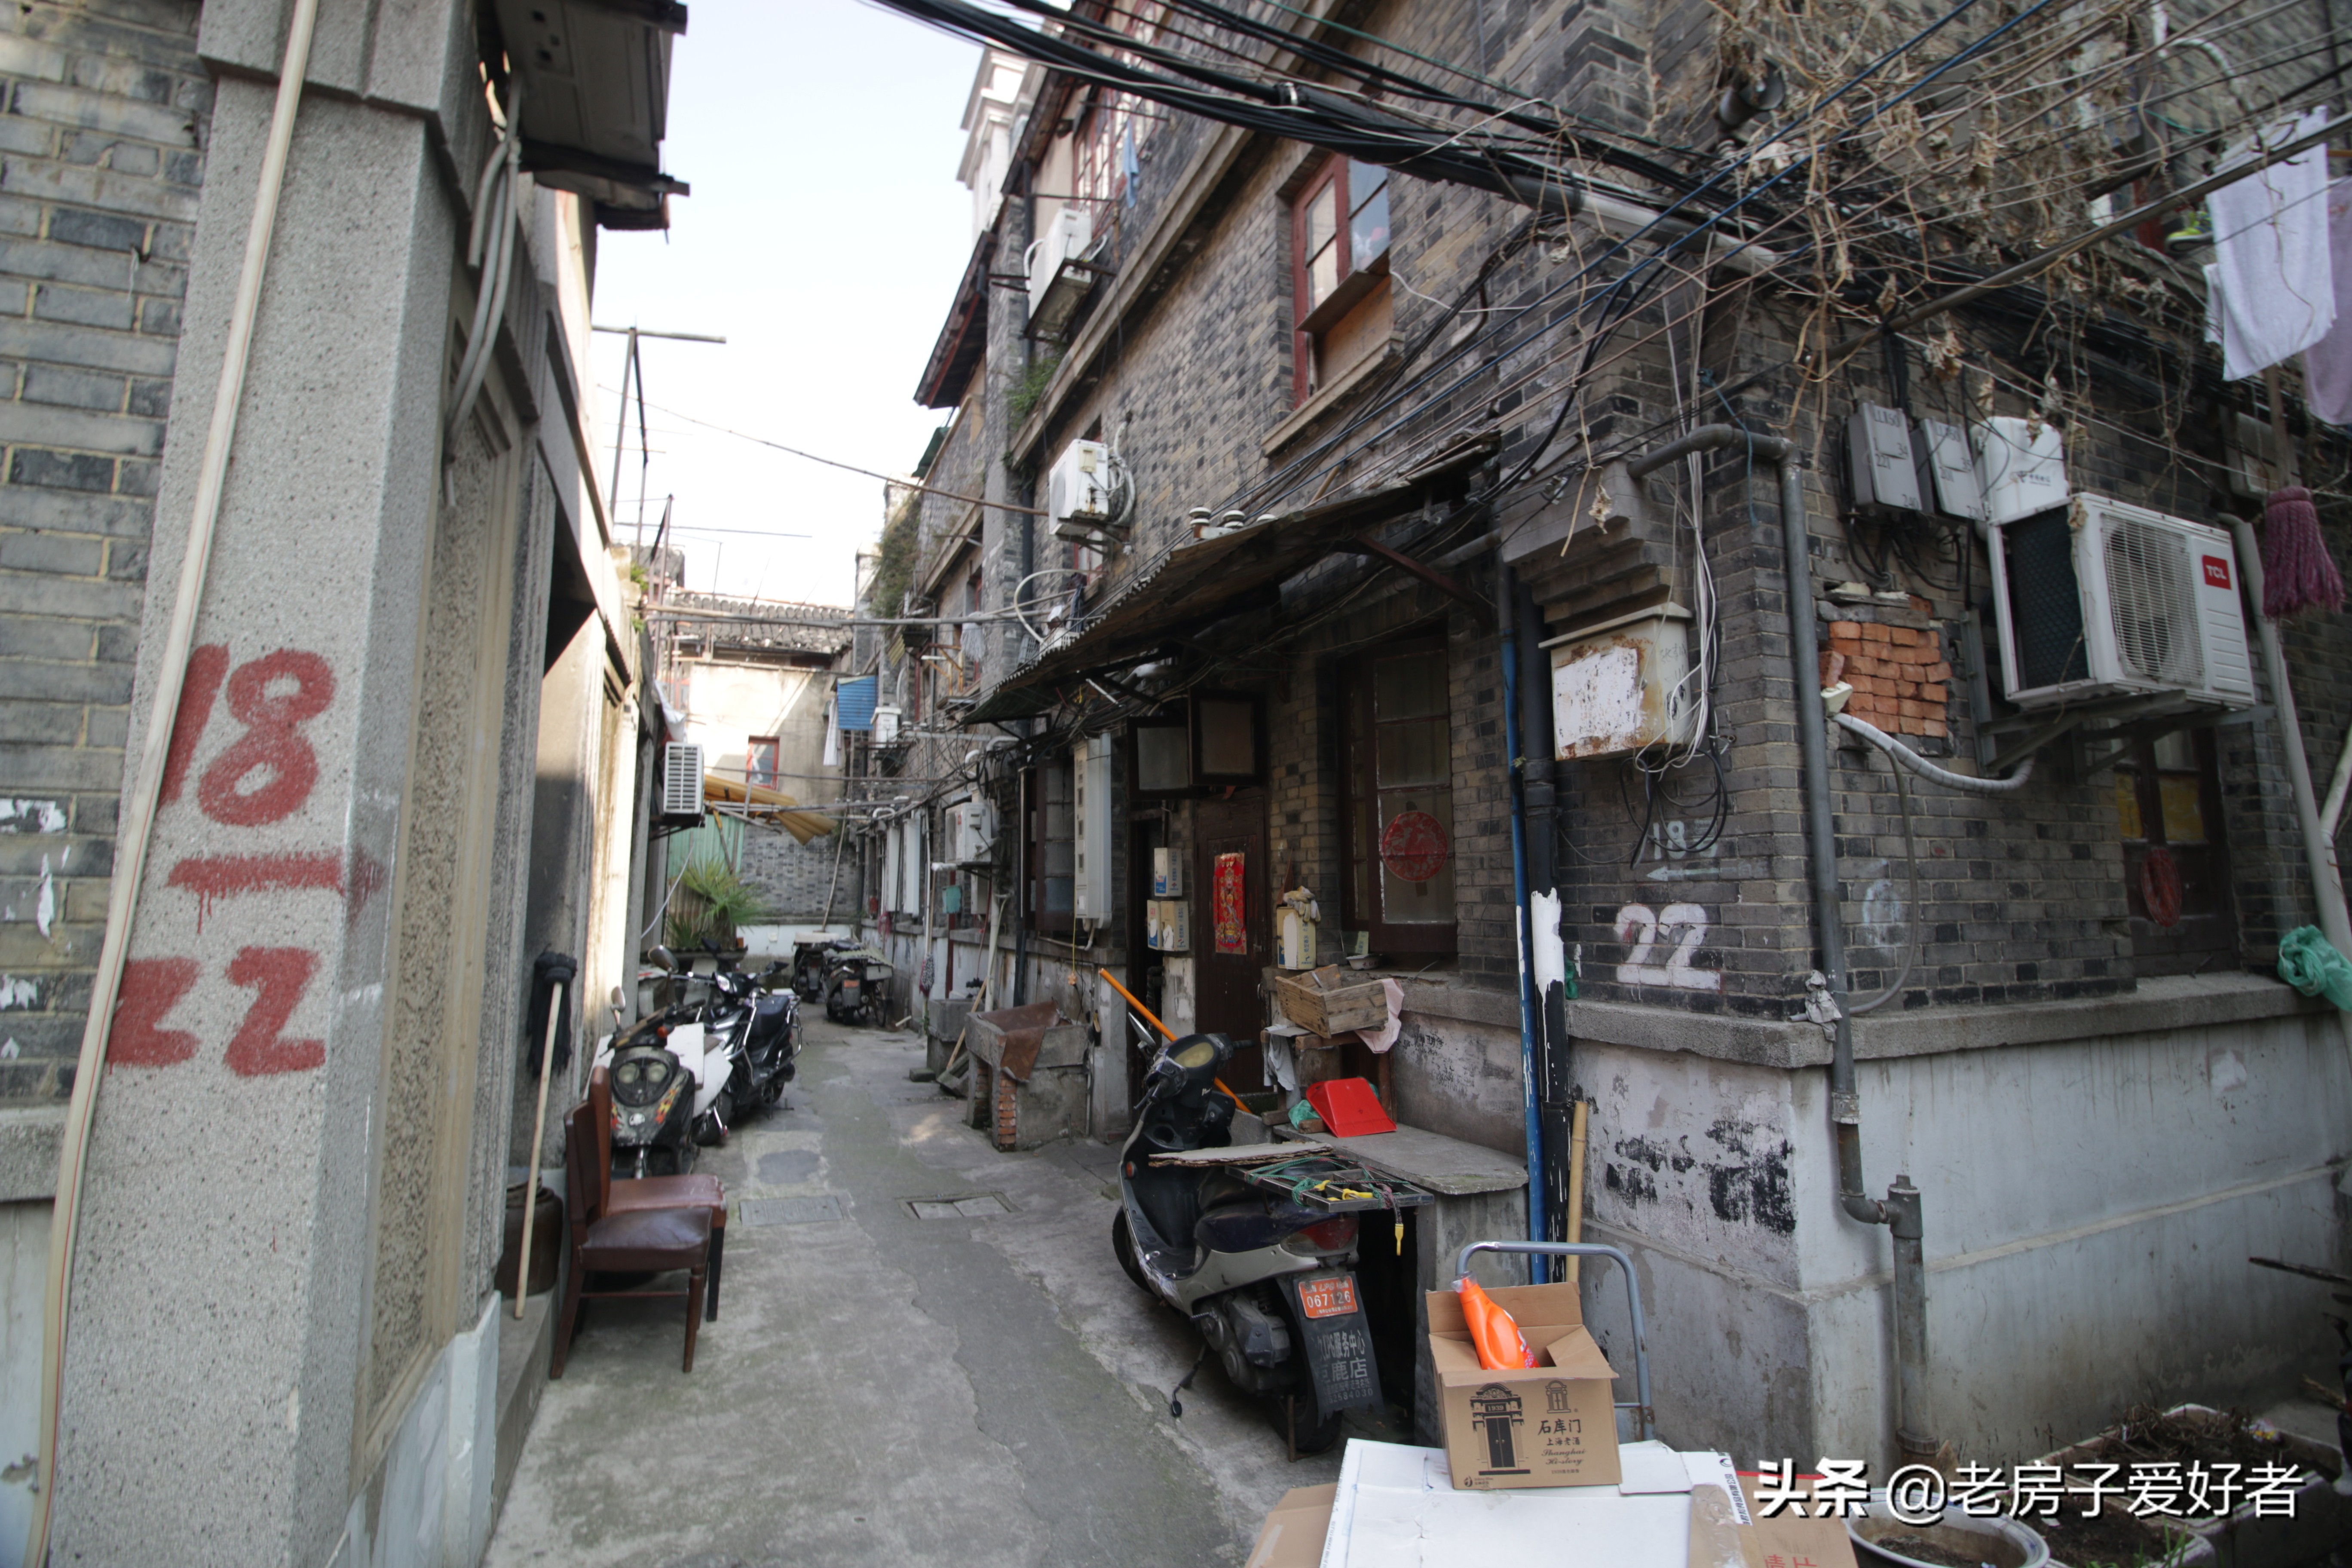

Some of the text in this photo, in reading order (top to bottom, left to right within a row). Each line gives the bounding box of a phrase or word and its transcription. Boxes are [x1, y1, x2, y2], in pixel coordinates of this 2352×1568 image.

[2205, 564, 2227, 580] TCL
[1614, 902, 1721, 990] 22
[1307, 1290, 1351, 1308] 067126
[1537, 1418, 1581, 1435] 石库门
[1547, 1437, 1580, 1446] 上海老酒
[1541, 1448, 1586, 1458] Shanghai
